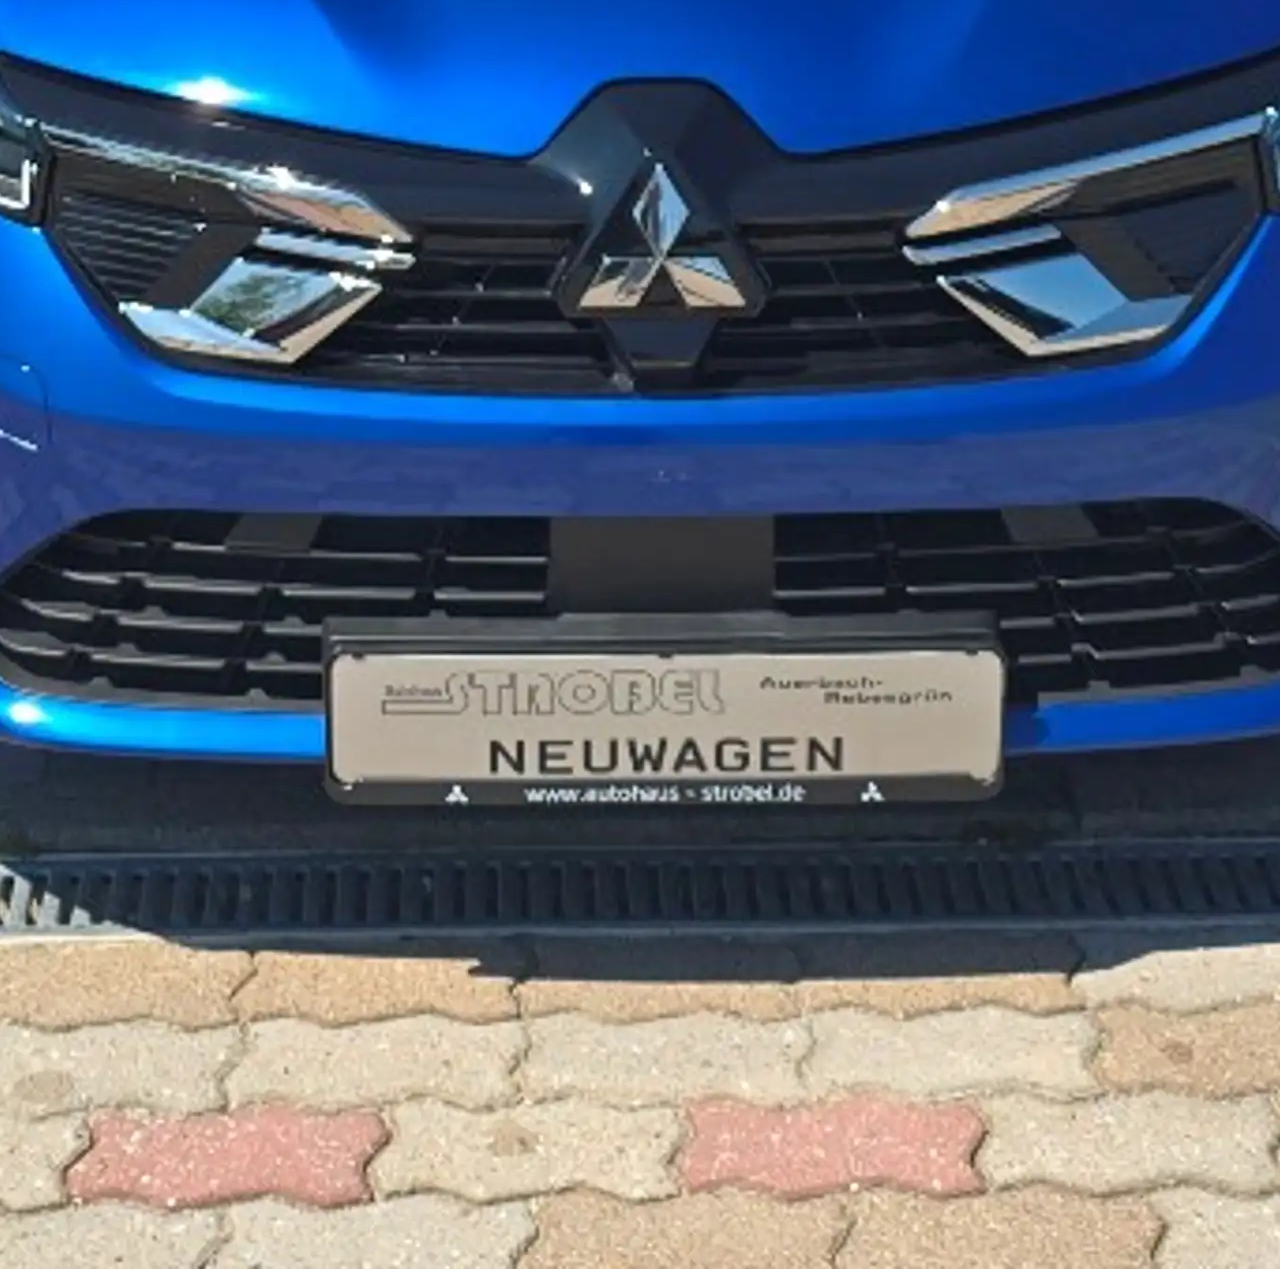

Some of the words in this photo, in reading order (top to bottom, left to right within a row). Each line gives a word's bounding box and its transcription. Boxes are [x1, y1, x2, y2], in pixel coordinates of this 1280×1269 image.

[489, 736, 845, 775] NEUWAGEN
[522, 783, 681, 807] www.autohaus
[699, 782, 806, 805] strobel.de
